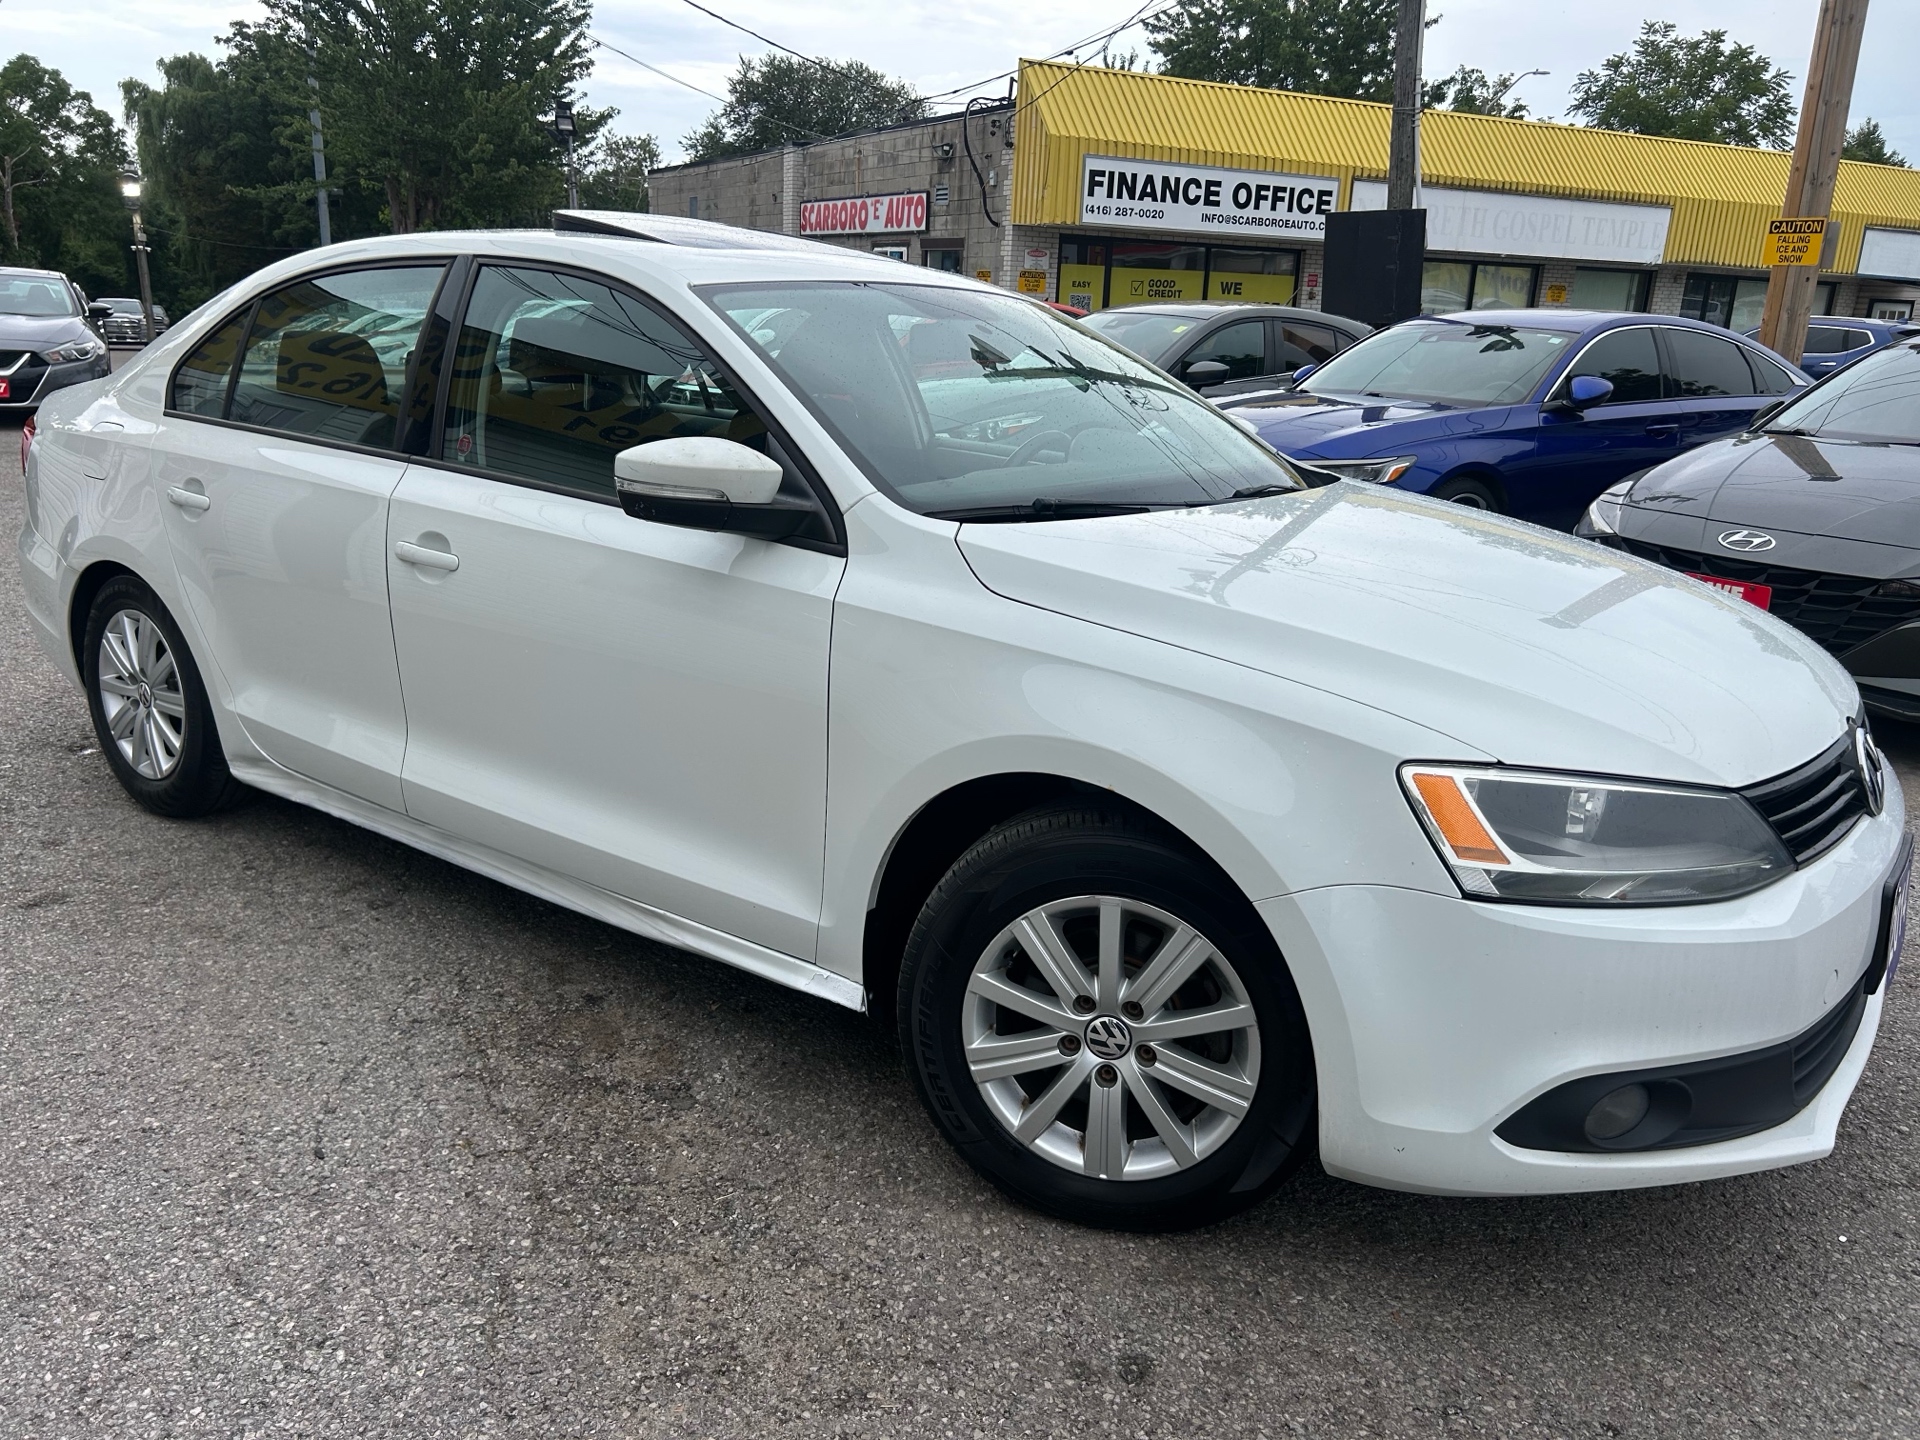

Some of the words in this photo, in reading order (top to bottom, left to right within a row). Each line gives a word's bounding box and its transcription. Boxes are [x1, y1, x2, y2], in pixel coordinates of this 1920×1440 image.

[1087, 169, 1222, 207] FINANCE
[1231, 182, 1333, 216] OFFICE
[800, 200, 869, 232] SCARBORO
[884, 194, 925, 229] AUTO
[1085, 204, 1112, 216] (416)
[1114, 206, 1165, 220] 287-0020
[1201, 212, 1326, 231] INFO@SCARBOROEAUTO.C
[1771, 221, 1822, 233] CAUTION
[1492, 209, 1576, 246] GOSPEL
[1583, 215, 1666, 252] TEMPLE
[1777, 235, 1811, 244] FALLING
[1776, 245, 1790, 254] ICE
[1791, 245, 1809, 254] AND
[1778, 255, 1804, 264] SNOW
[1020, 271, 1046, 279] CAUTION
[1072, 280, 1092, 289] EASY
[1148, 278, 1177, 290] GOOD
[1220, 281, 1243, 296] WE
[1147, 288, 1183, 300] CREDIT
